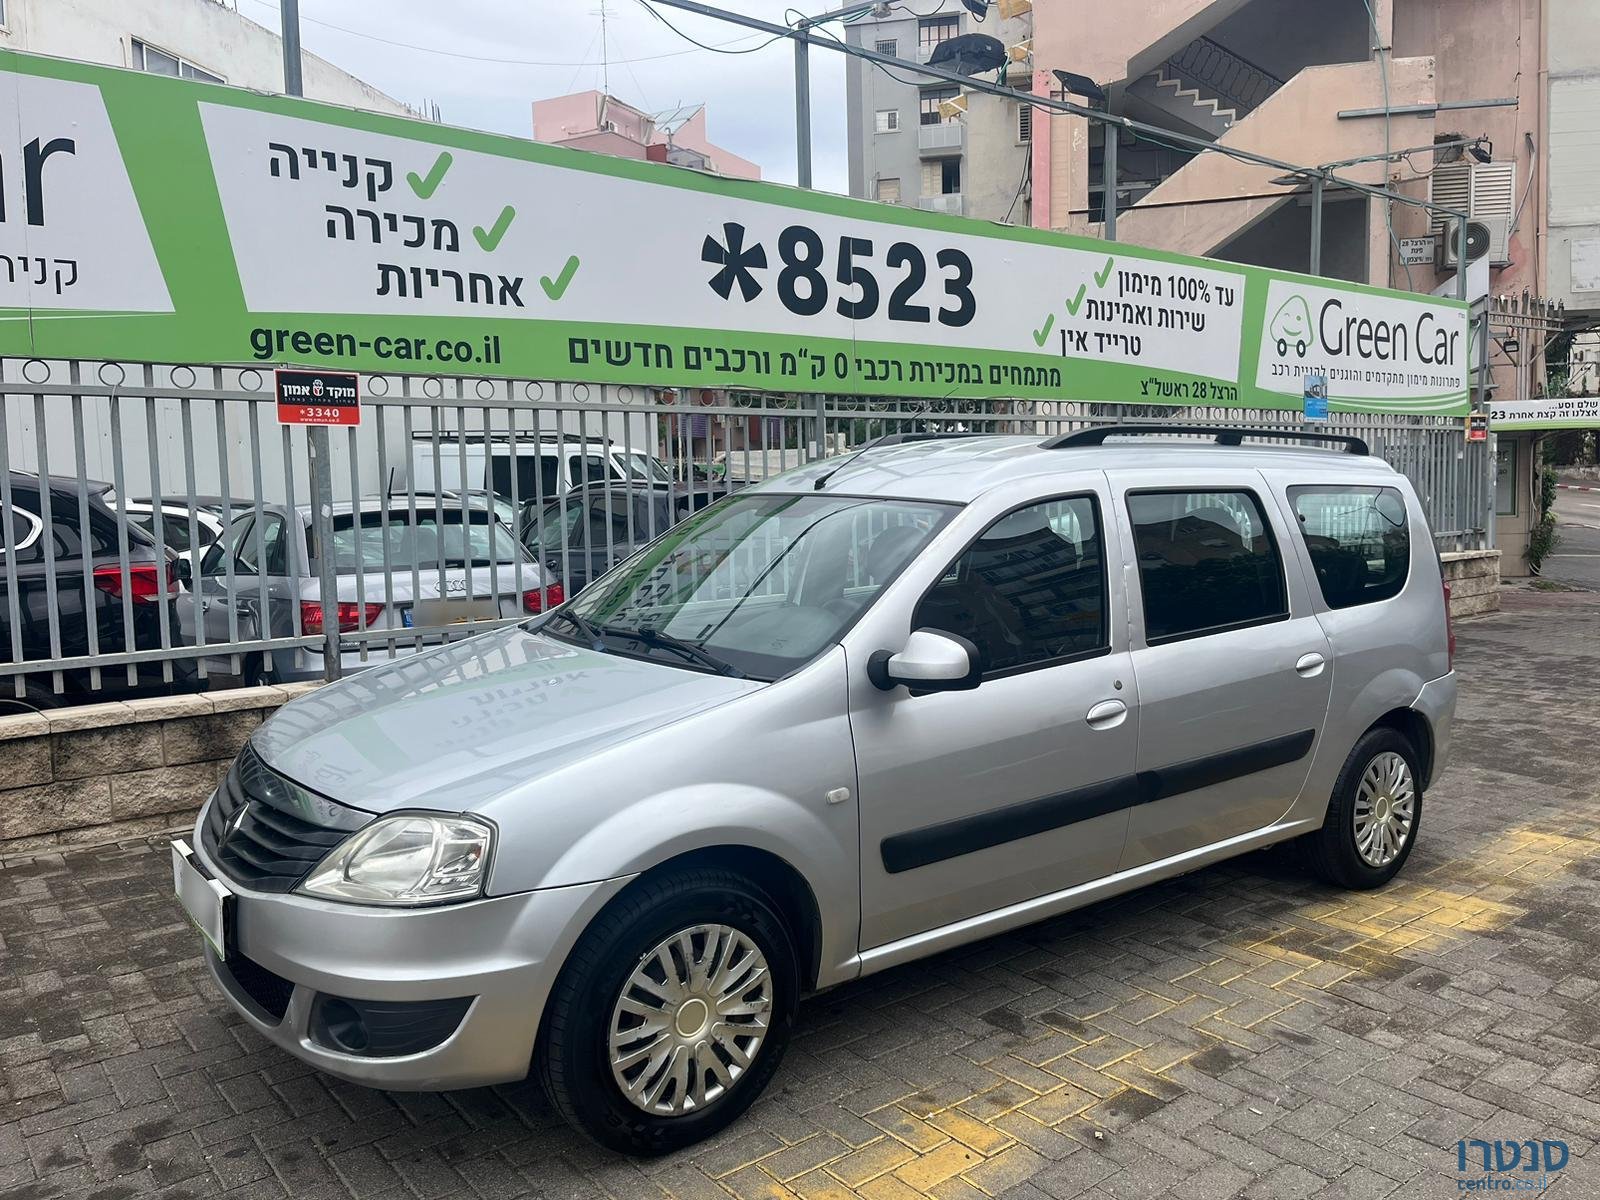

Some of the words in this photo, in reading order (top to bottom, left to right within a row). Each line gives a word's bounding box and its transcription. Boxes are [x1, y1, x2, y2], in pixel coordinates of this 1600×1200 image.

[268, 142, 393, 202] קנייה
[325, 204, 460, 253] מכירה
[377, 262, 524, 308] אחריות
[1118, 269, 1162, 297] מימון
[1167, 275, 1211, 304] 100%
[1214, 285, 1235, 307] עד
[1085, 298, 1153, 326] ואמינות
[1157, 307, 1206, 332] שירות
[1060, 328, 1089, 357] אין
[1093, 332, 1142, 357] טרייד
[1319, 298, 1408, 362] Green
[1415, 312, 1460, 366] Car
[249, 326, 502, 365] green-car.co.il
[568, 337, 673, 369] חדשים
[683, 345, 771, 375] ורכבים
[779, 347, 826, 380] ק"מ
[833, 352, 849, 380] 0
[854, 357, 903, 382] רכבי
[909, 360, 984, 385] במכירת
[1271, 363, 1290, 376] רכב
[989, 363, 1062, 388] מתמחים
[1329, 367, 1362, 381] והוגנים
[1365, 370, 1404, 387] מתקדמים
[1406, 373, 1428, 388] מימון
[1430, 376, 1461, 389] פתרונות
[282, 384, 311, 397] אמון
[325, 386, 356, 398] מוקד
[1140, 377, 1190, 398] ראשל"צ
[1191, 381, 1207, 399] 28
[1210, 380, 1238, 401] הרצל
[1491, 410, 1506, 420] 23
[1508, 411, 1535, 420] אחרת
[1537, 410, 1557, 420] קצת
[1559, 410, 1570, 418] זה
[1572, 409, 1599, 417] אצלנו
[1577, 400, 1598, 409] שלם
